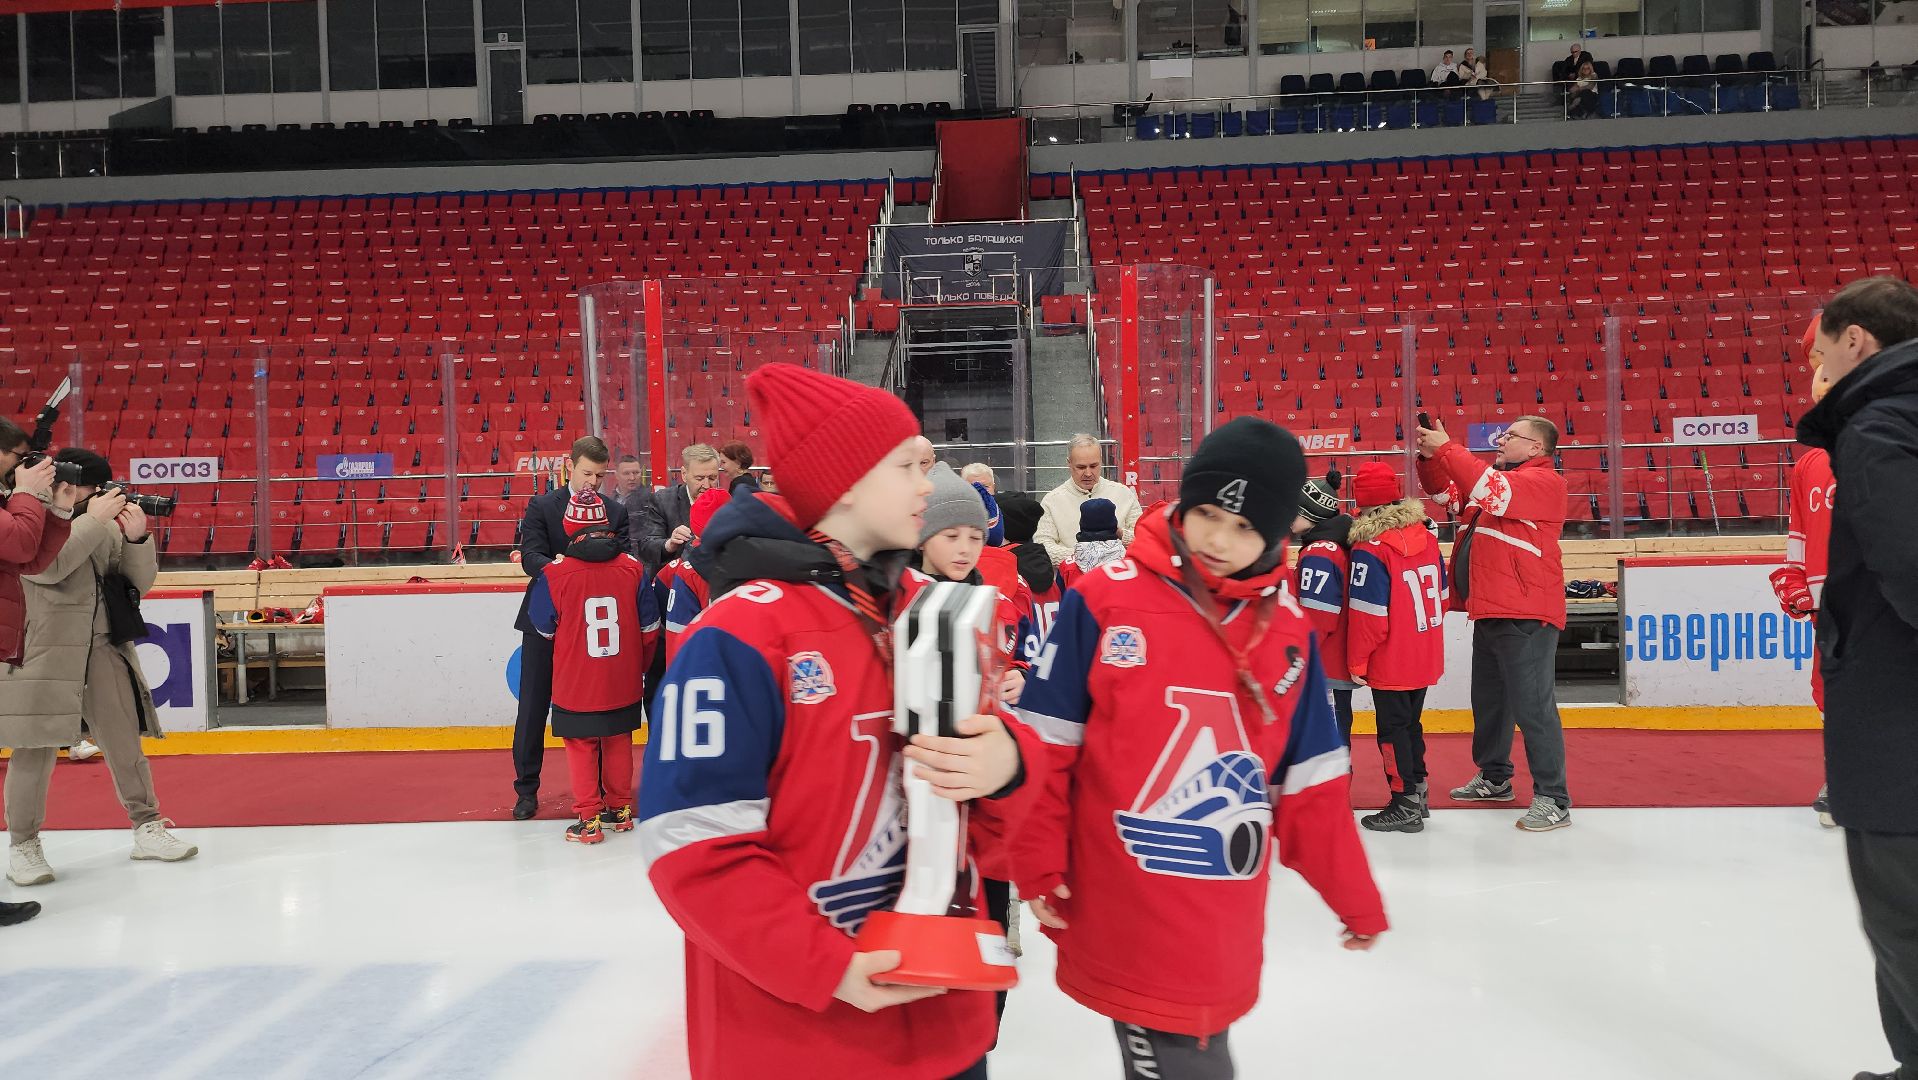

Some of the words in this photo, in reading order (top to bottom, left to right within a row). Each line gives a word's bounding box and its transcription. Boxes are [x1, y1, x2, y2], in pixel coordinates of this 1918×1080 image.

[924, 235, 964, 246] ТОЛЬКО
[968, 234, 1024, 244] БАЛАШИХА!
[1298, 434, 1349, 450] NBET
[1216, 479, 1248, 513] 4
[1300, 567, 1330, 595] 87
[1350, 562, 1369, 587] 13
[1402, 564, 1443, 632] 13
[584, 596, 620, 658] 8
[658, 676, 726, 761] 16
